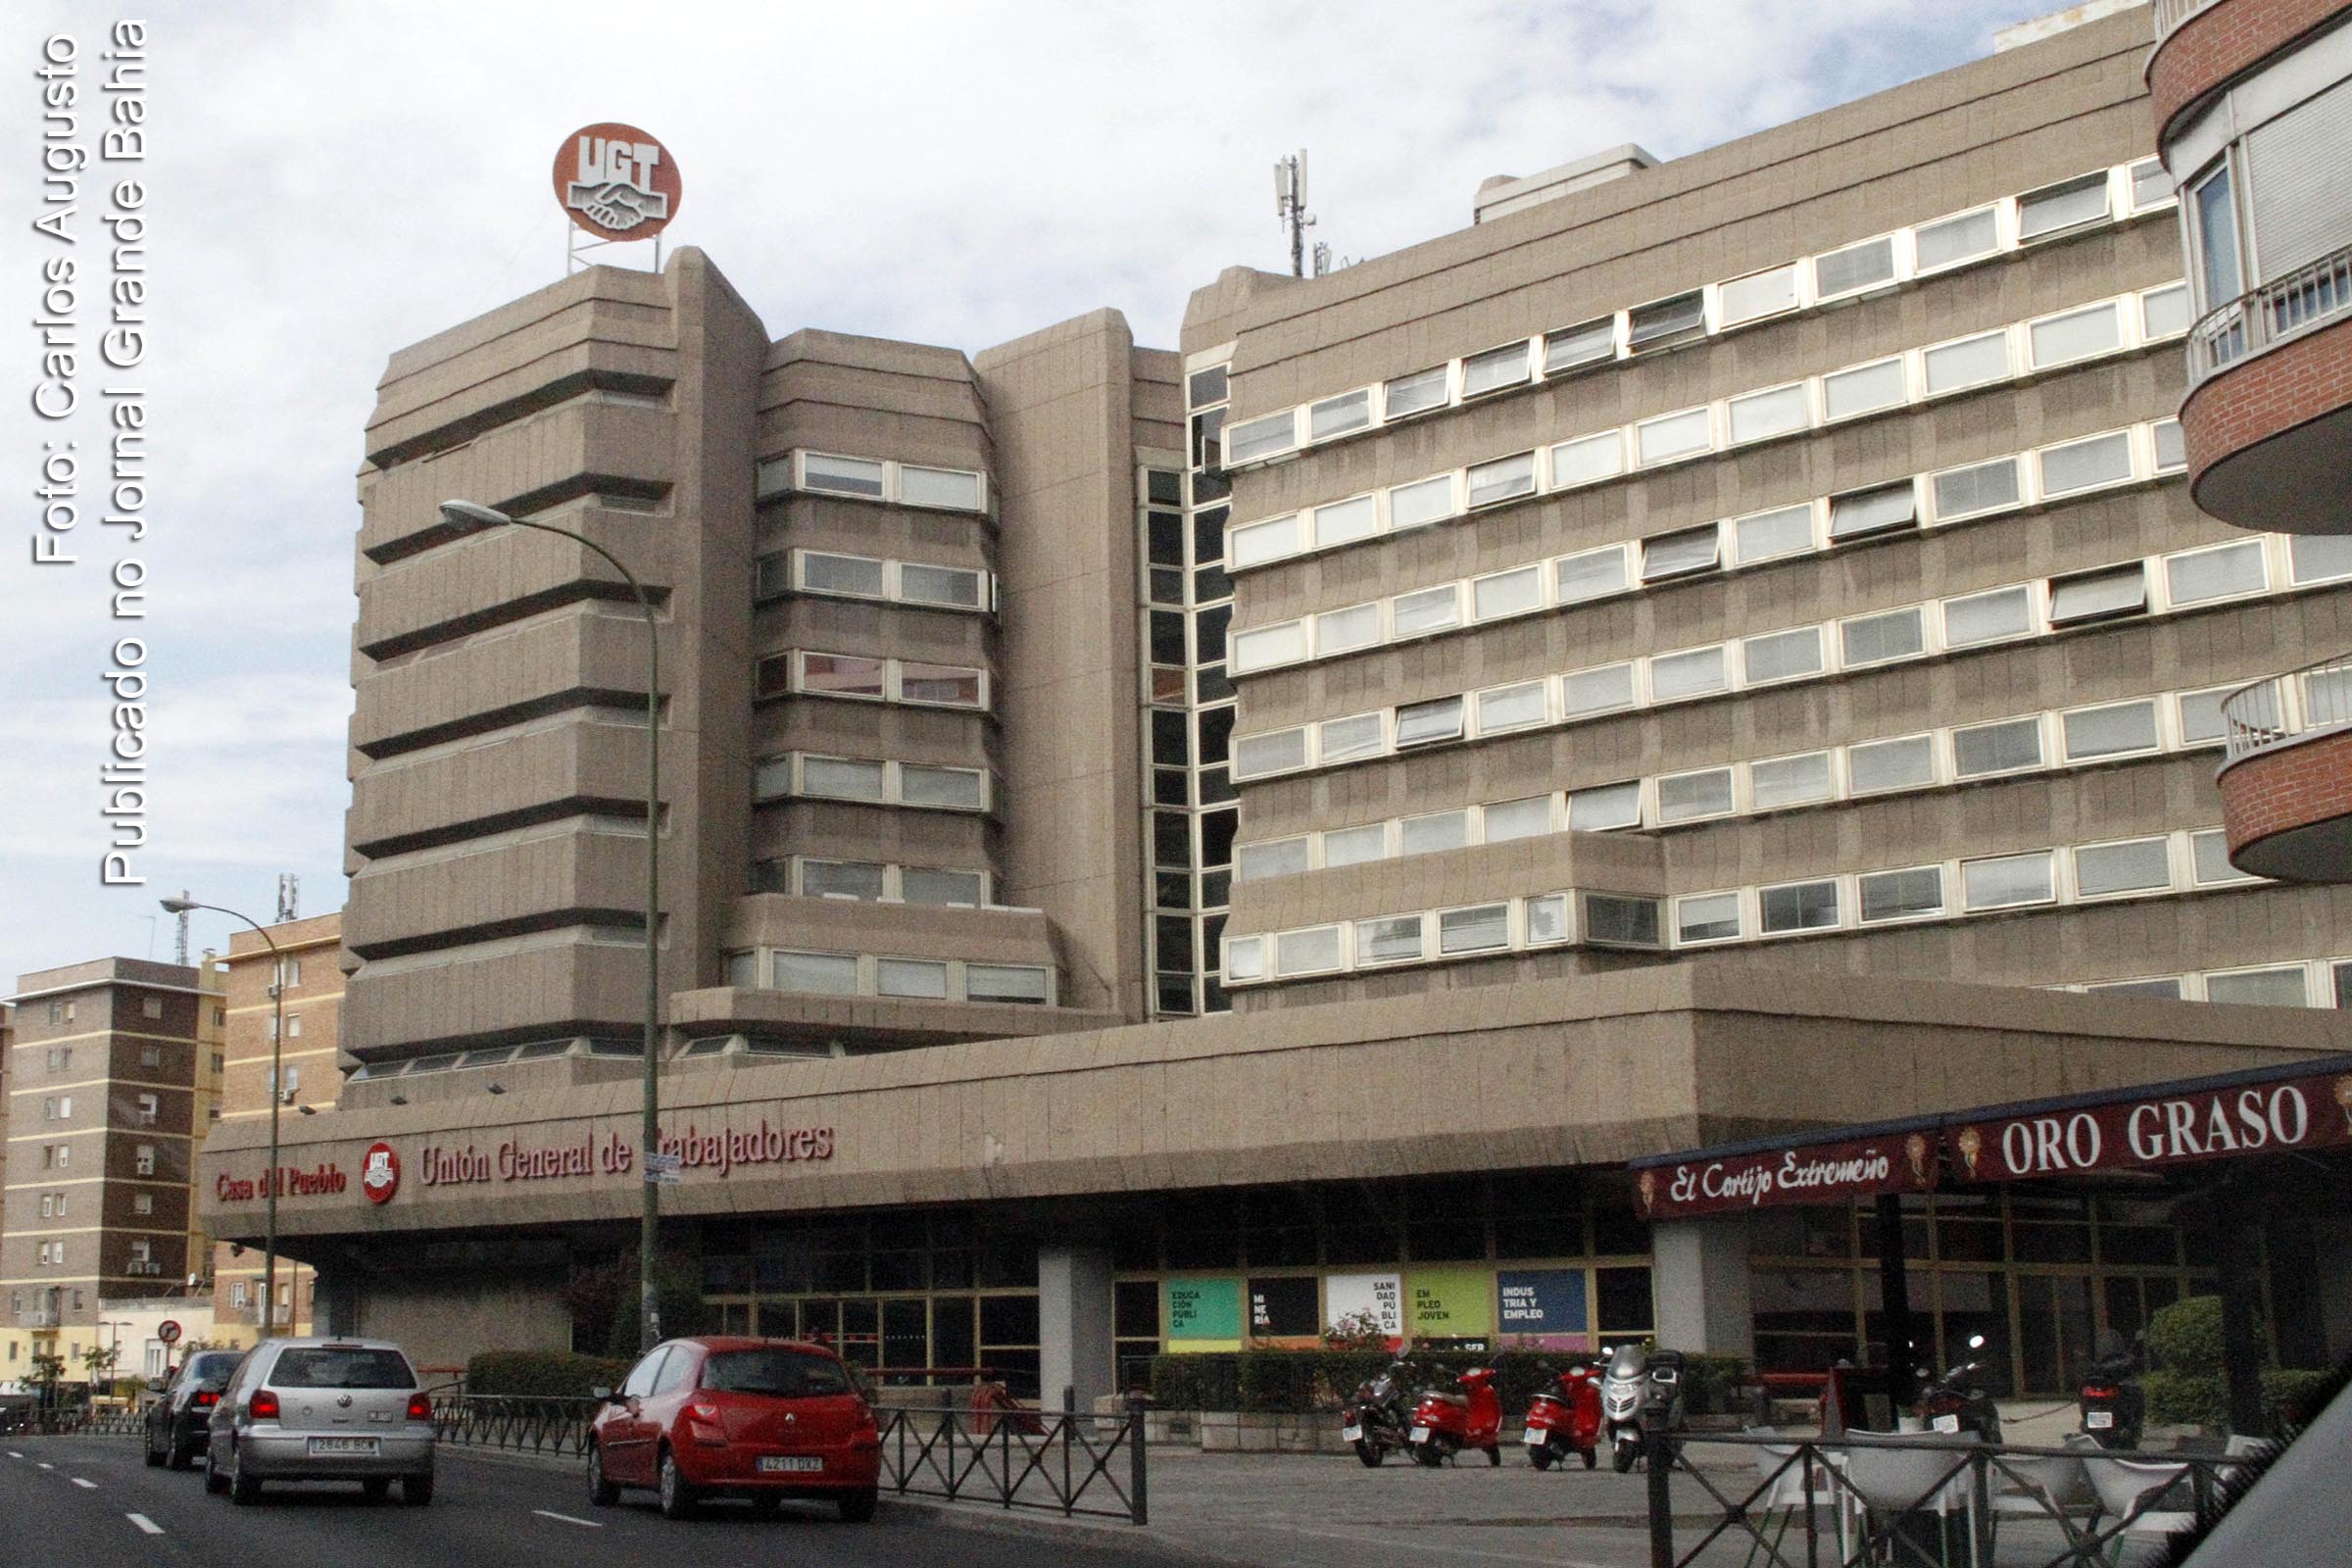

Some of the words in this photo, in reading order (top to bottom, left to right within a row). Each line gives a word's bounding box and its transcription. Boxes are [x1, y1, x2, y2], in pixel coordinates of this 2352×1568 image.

[578, 136, 660, 193] UGT
[2002, 1113, 2101, 1175] ORO
[2128, 1086, 2309, 1161] GRASO
[418, 1145, 492, 1186] Unión
[498, 1132, 595, 1182] General
[602, 1132, 633, 1174] de
[644, 1119, 835, 1177] rabajadores
[217, 1171, 255, 1202] Casa
[259, 1166, 284, 1199] dl
[290, 1163, 348, 1196] Pueblo
[1670, 1166, 1695, 1202] El
[1701, 1163, 1772, 1206] Cortijo
[1777, 1149, 1889, 1190] Extremeño
[1373, 1282, 1396, 1291] SANI
[1172, 1292, 1200, 1300] EDUCA
[1376, 1292, 1396, 1300] DAD
[1416, 1290, 1431, 1298] EM
[1502, 1287, 1534, 1298] INDUS
[1254, 1295, 1264, 1303] MI
[1503, 1298, 1527, 1308] TRIA
[1530, 1298, 1538, 1308] Y
[1254, 1304, 1266, 1314] NE
[1383, 1300, 1396, 1310] PÚ
[1417, 1300, 1442, 1309] PLEO
[1382, 1310, 1396, 1320] BLI
[1417, 1310, 1449, 1320] JOVEN
[1503, 1309, 1544, 1320] EMPLEO
[1384, 1320, 1396, 1330] CA
